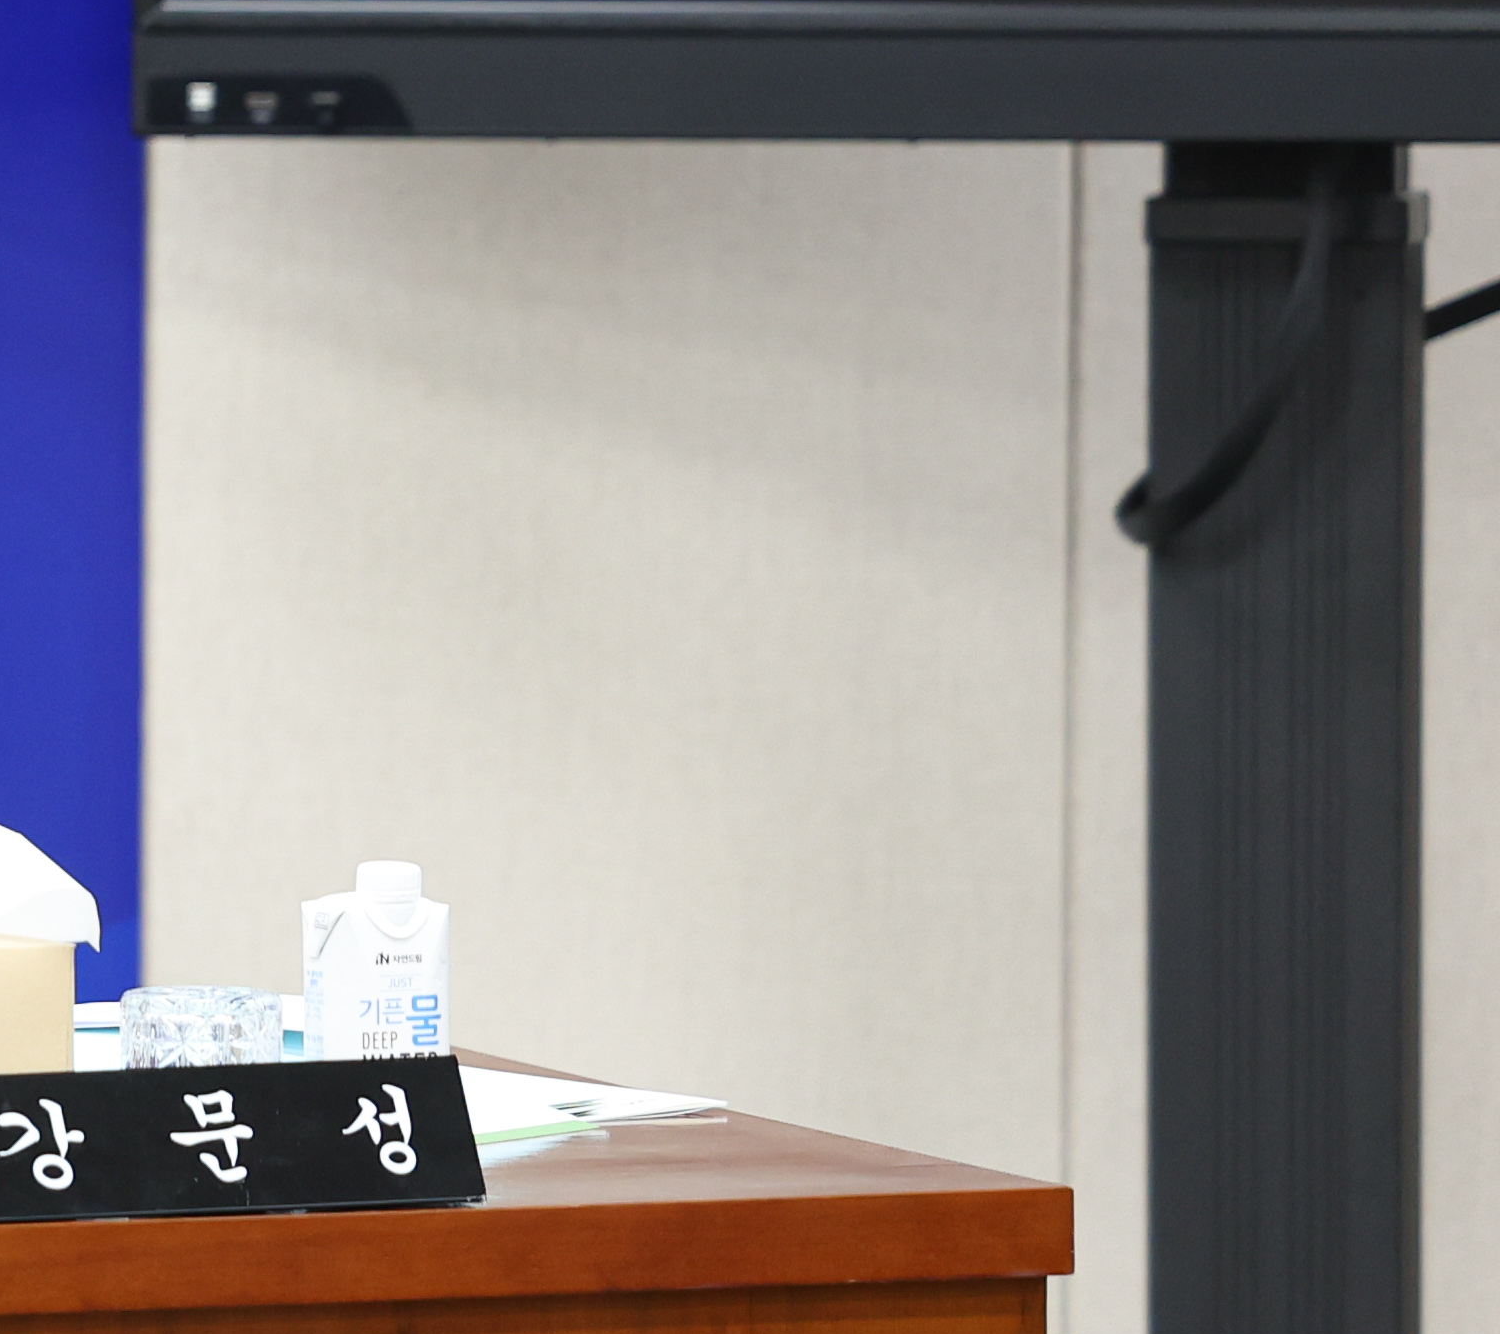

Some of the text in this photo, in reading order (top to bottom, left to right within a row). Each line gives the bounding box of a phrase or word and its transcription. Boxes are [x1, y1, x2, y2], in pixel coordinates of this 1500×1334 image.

[387, 976, 413, 989] JUST
[405, 993, 442, 1047] 물
[361, 1031, 399, 1050] DEEP
